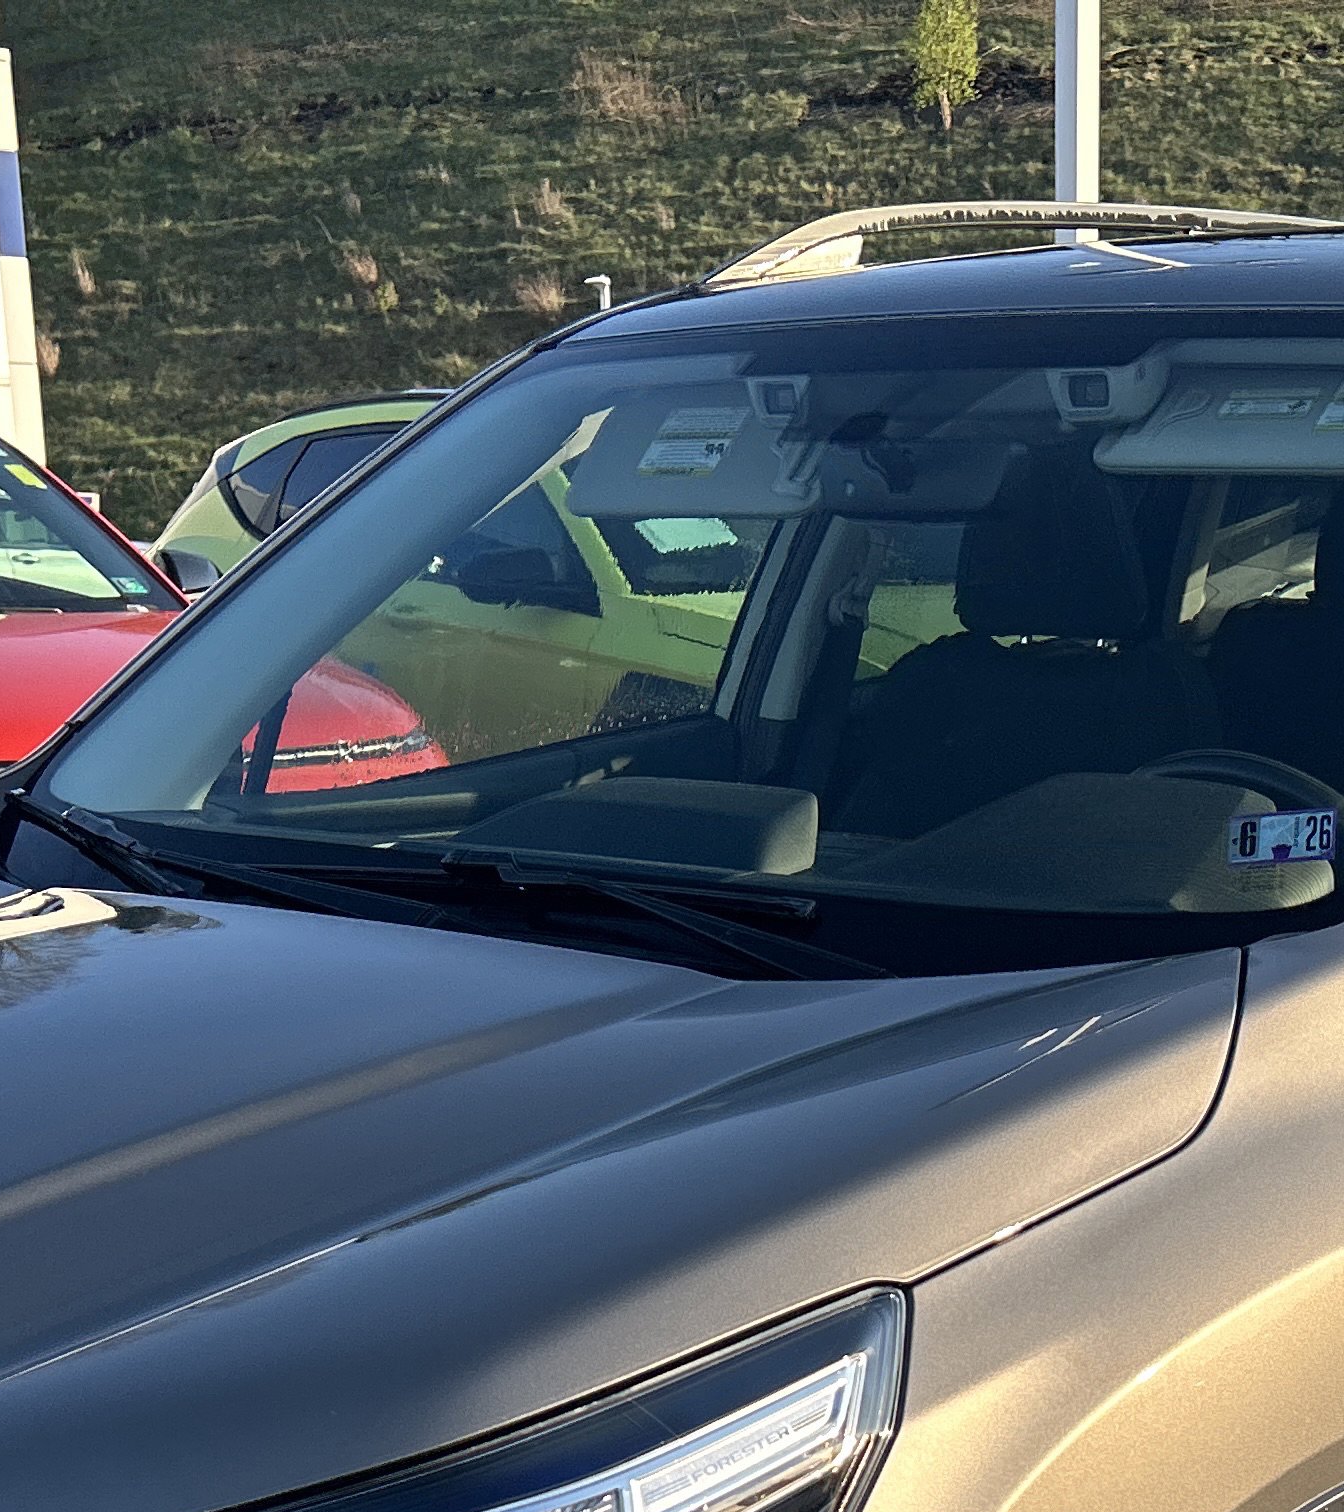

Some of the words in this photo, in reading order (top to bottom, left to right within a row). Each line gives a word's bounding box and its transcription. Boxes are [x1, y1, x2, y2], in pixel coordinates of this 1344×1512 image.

[1239, 821, 1257, 857] 6
[1305, 814, 1332, 852] 26
[690, 1424, 790, 1483] FORESTER
